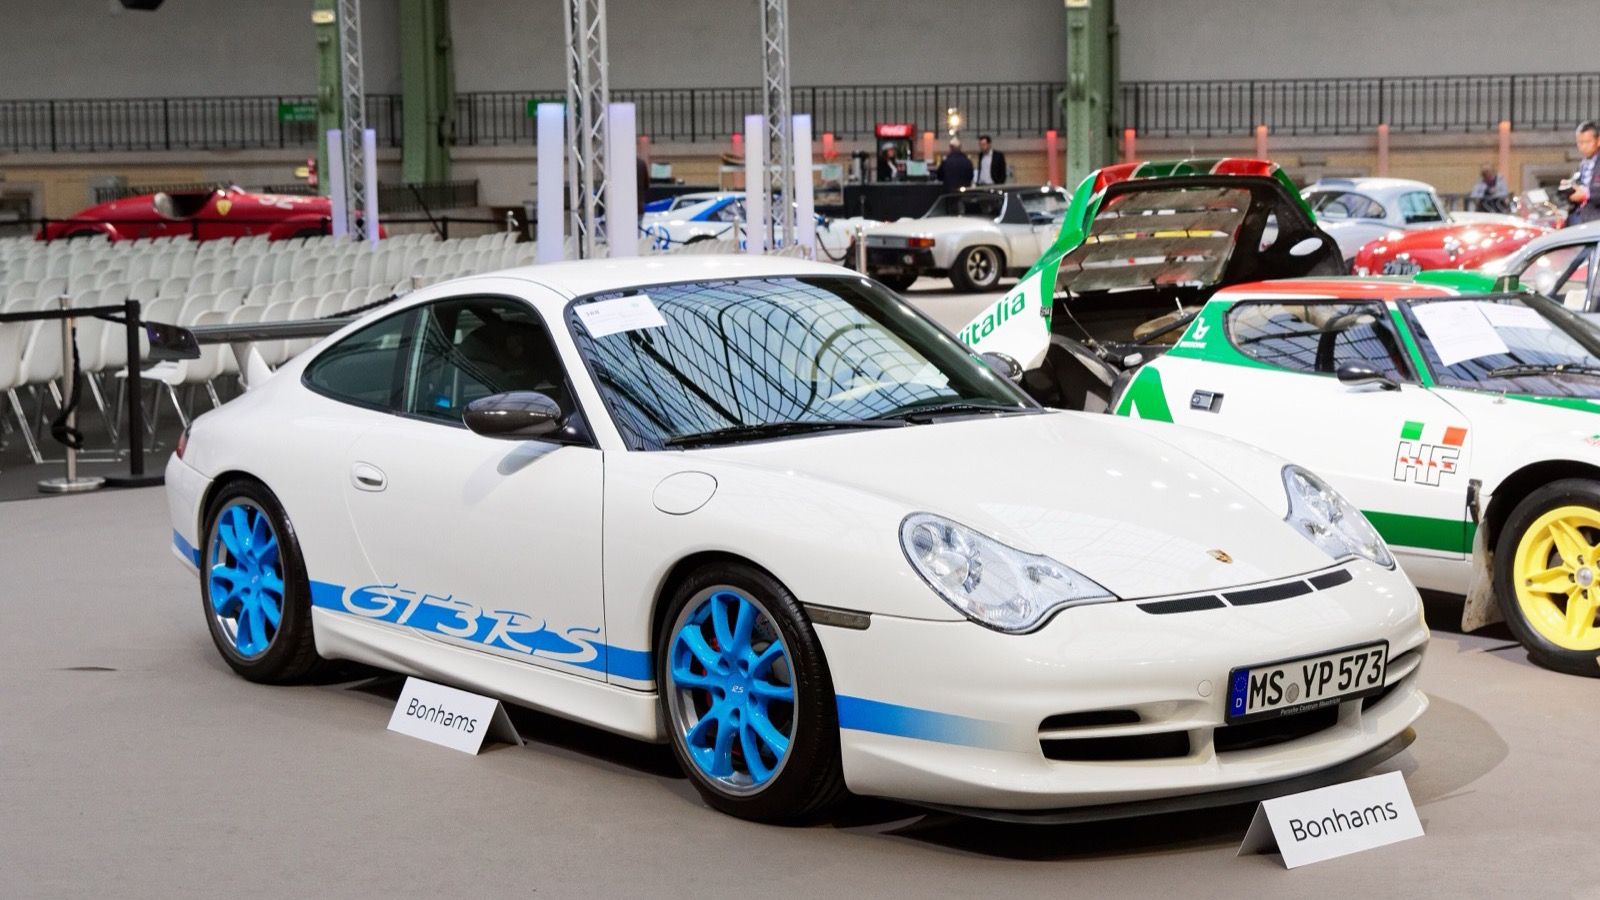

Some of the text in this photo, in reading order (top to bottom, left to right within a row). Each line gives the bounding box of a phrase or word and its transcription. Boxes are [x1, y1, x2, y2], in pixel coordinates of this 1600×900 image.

[1393, 440, 1461, 487] HF
[1235, 650, 1383, 709] D MS YP 573
[406, 697, 477, 733] Bonhams
[1289, 802, 1398, 842] Bonhams
